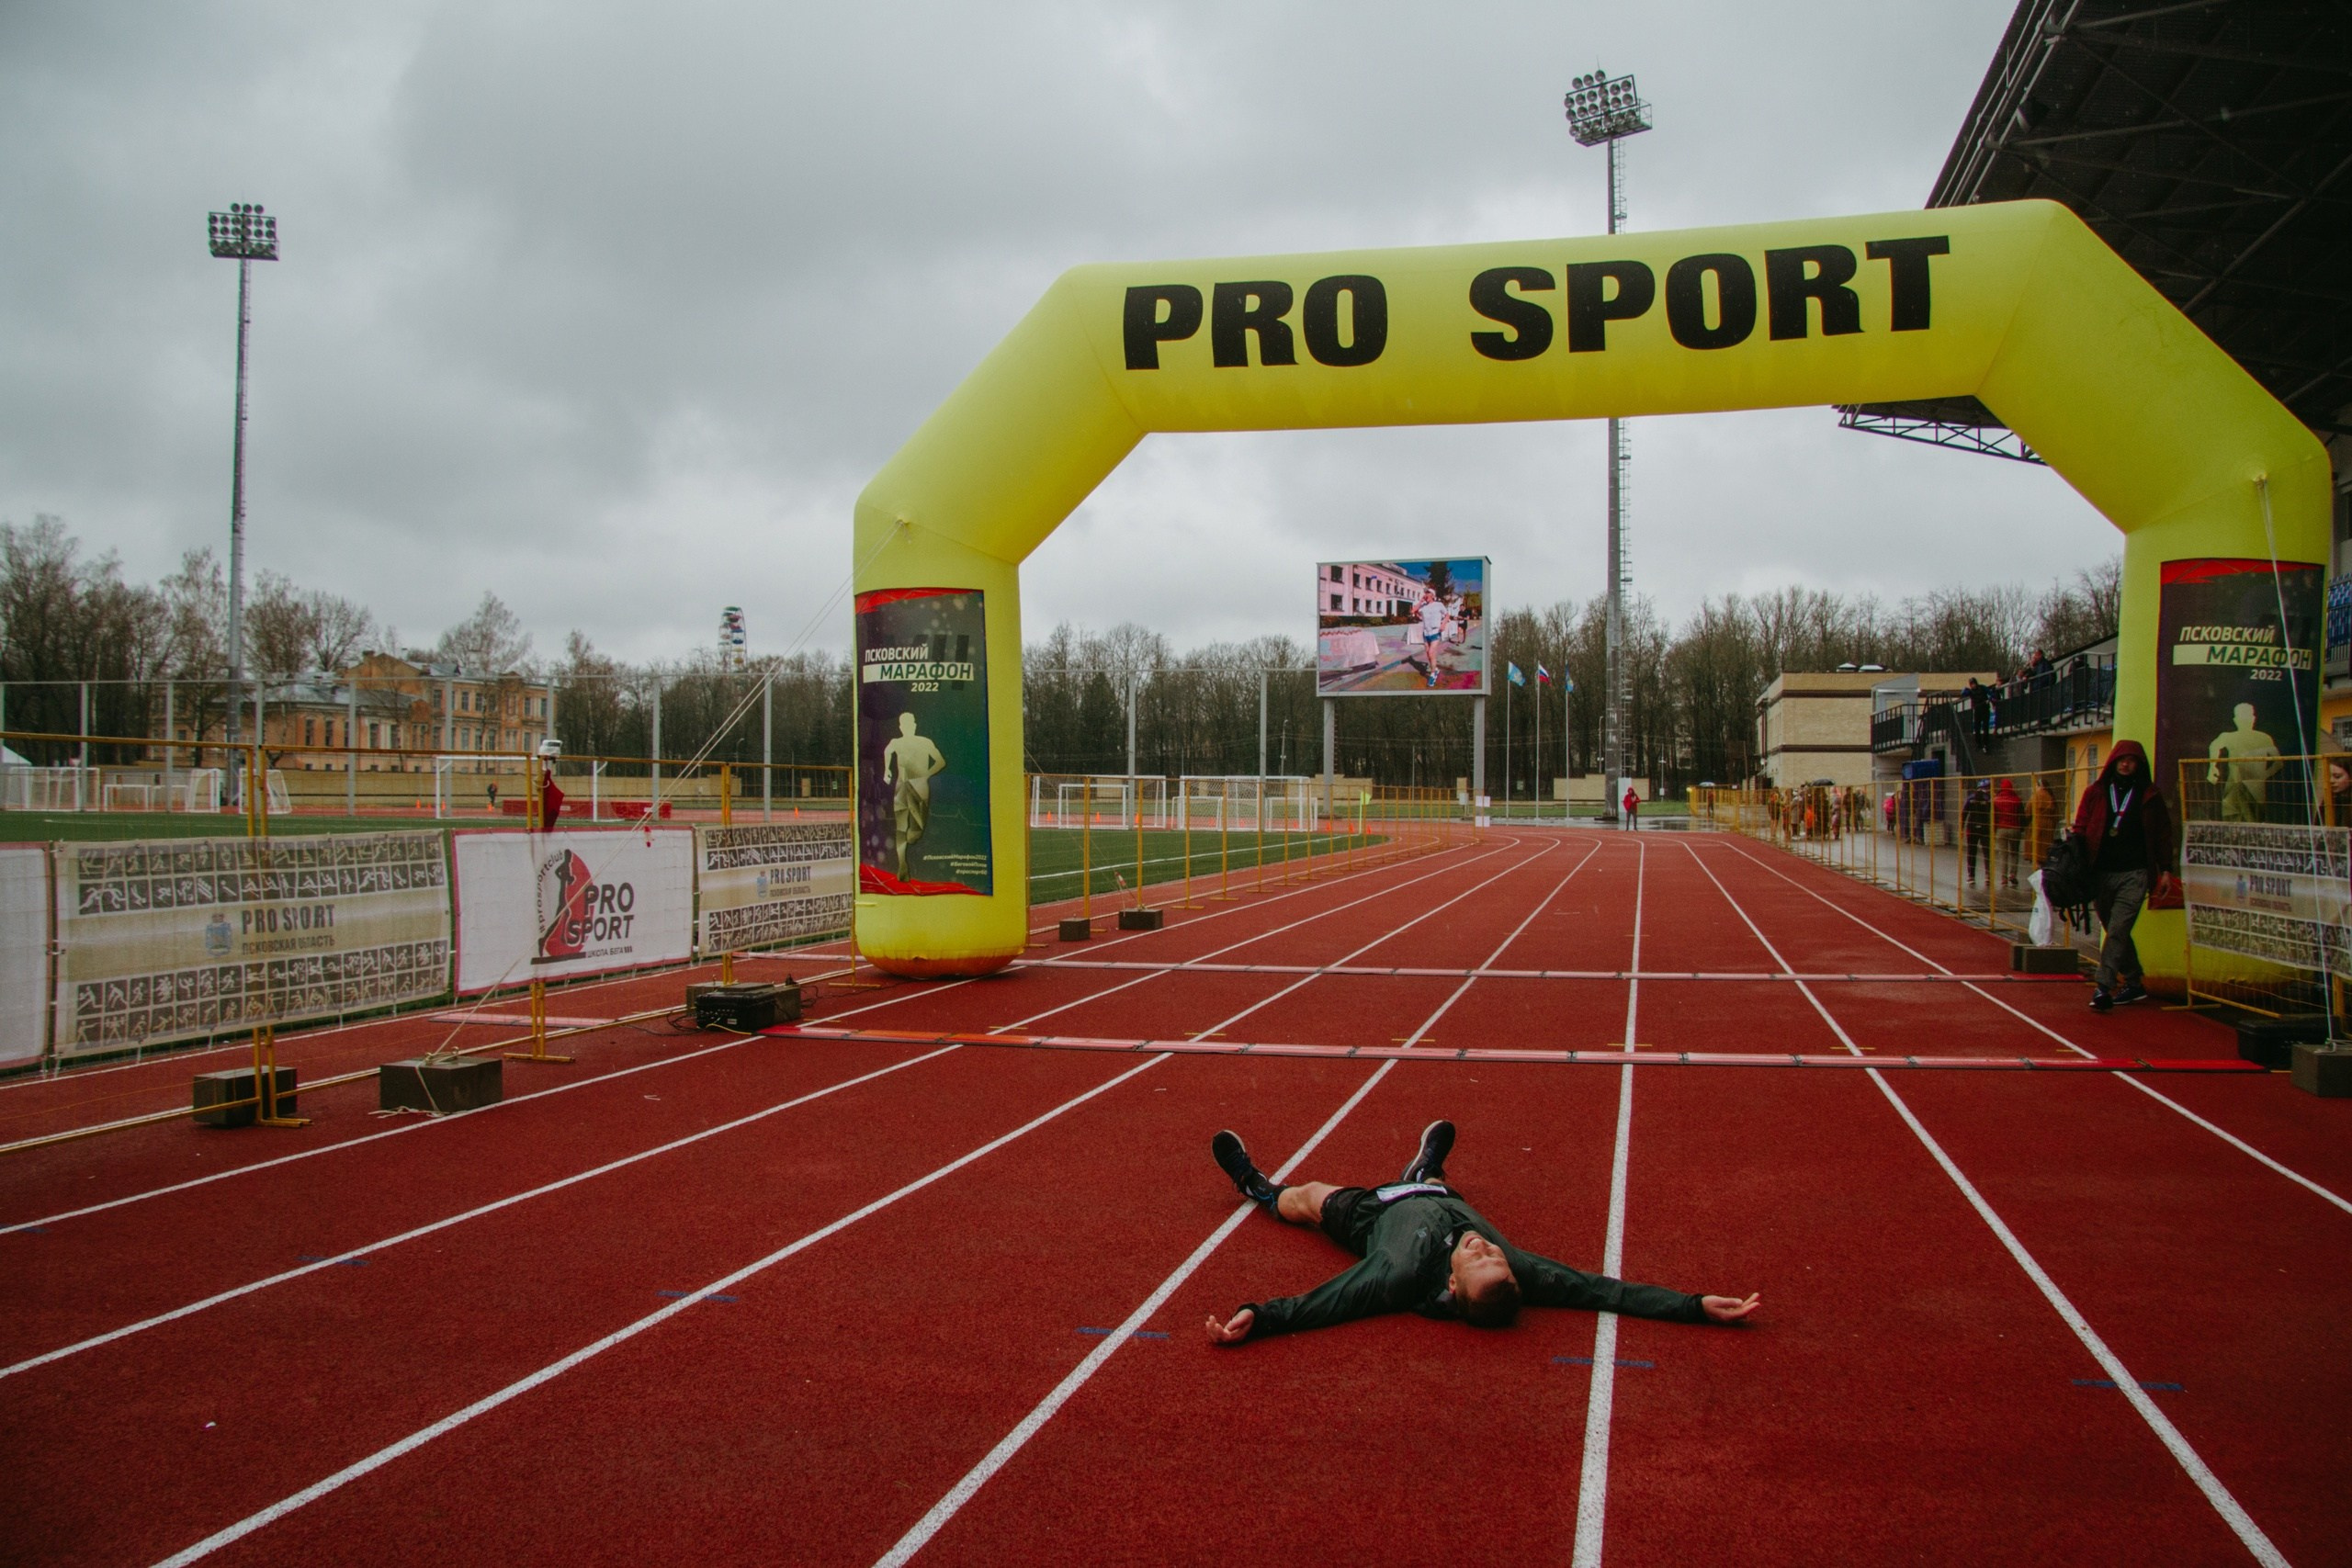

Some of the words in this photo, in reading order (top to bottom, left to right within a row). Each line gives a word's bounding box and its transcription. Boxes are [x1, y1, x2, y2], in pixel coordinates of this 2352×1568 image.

[1124, 276, 1388, 370] PRO
[1469, 235, 1951, 361] SPORT
[2179, 626, 2275, 643] ПСКОВСКИЙ
[865, 643, 929, 662] ПСКОВСКИЙ
[2206, 645, 2312, 670] МАРАФОН
[880, 662, 972, 681] МАРАФОН
[2250, 669, 2282, 681] 2022
[910, 682, 939, 693] 2022
[770, 868, 785, 885] PRO
[786, 866, 811, 883] SPORT
[583, 882, 635, 916] PRO
[243, 908, 278, 934] PRO
[283, 904, 334, 931] SPORT
[567, 915, 634, 945] SPORT
[243, 939, 297, 955] ПСКОВСКАЯ
